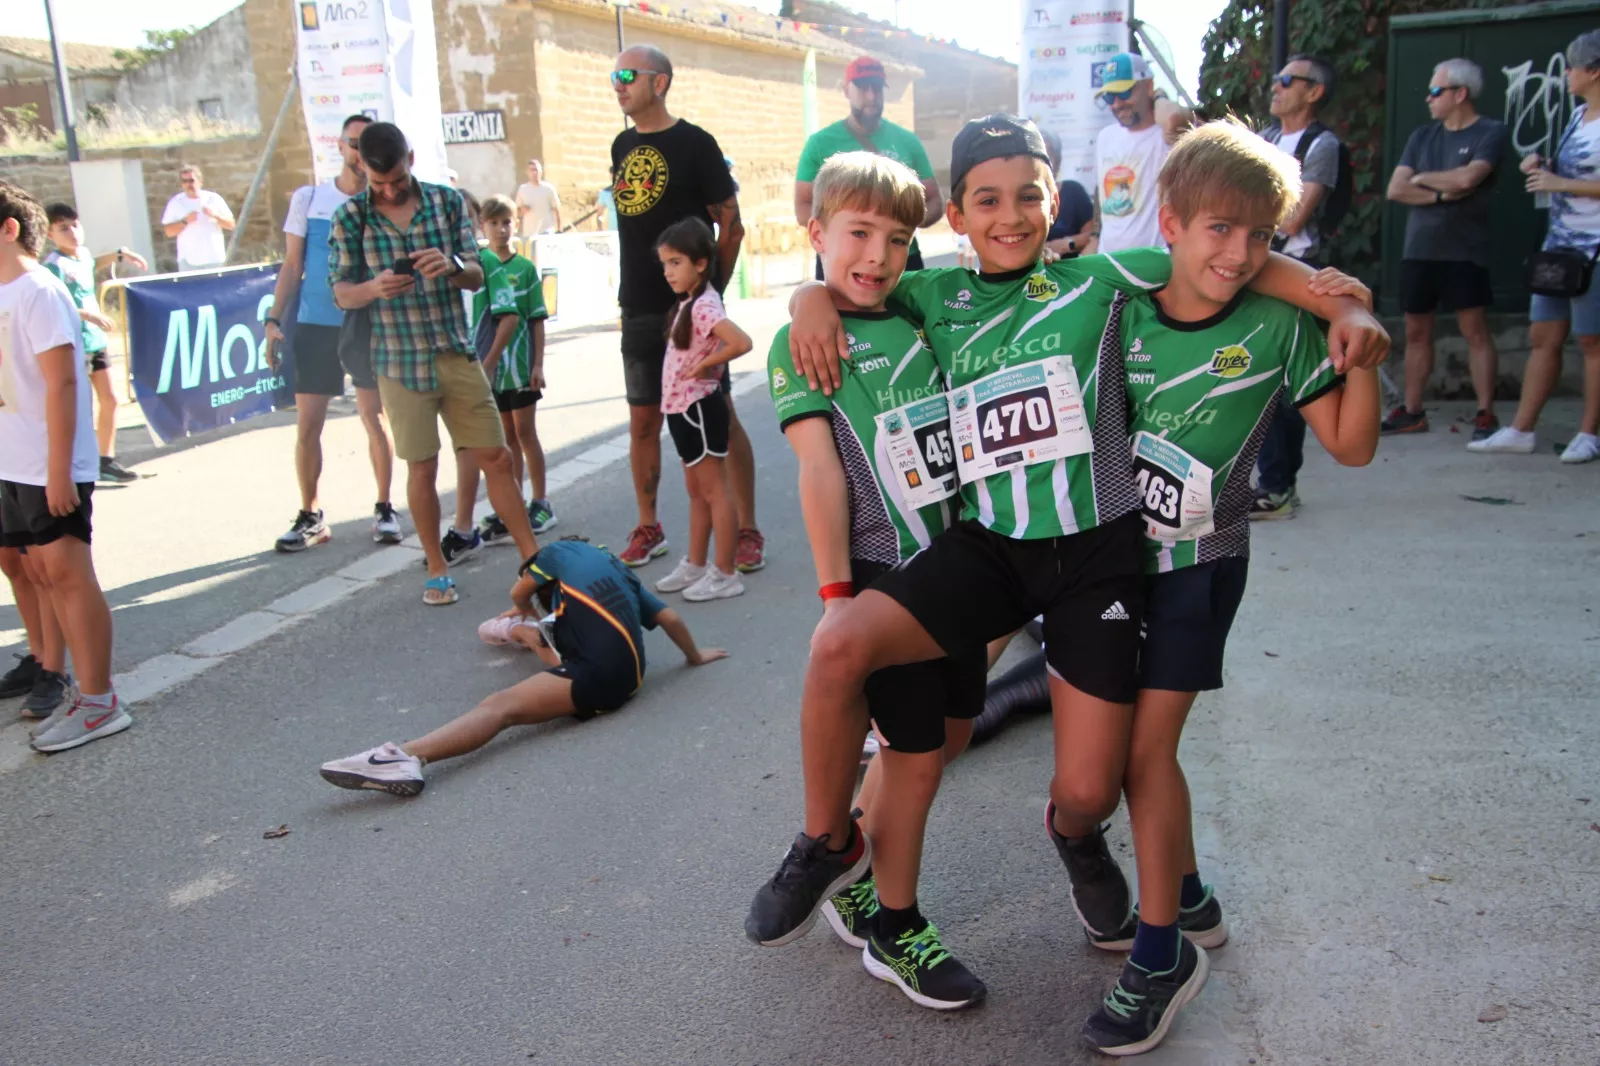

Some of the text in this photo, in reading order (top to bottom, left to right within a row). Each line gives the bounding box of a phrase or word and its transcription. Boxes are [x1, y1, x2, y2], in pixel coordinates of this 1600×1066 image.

[442, 112, 505, 143] RTESANIA
[848, 342, 872, 354] ATOR
[951, 332, 1061, 374] Huesca
[1126, 354, 1152, 362] ATOR
[876, 384, 940, 412] Huesc
[982, 396, 1052, 442] 470
[1141, 405, 1218, 431] uesca
[926, 429, 953, 468] 45
[1133, 468, 1179, 520] 463
[1101, 612, 1130, 620] adidas
